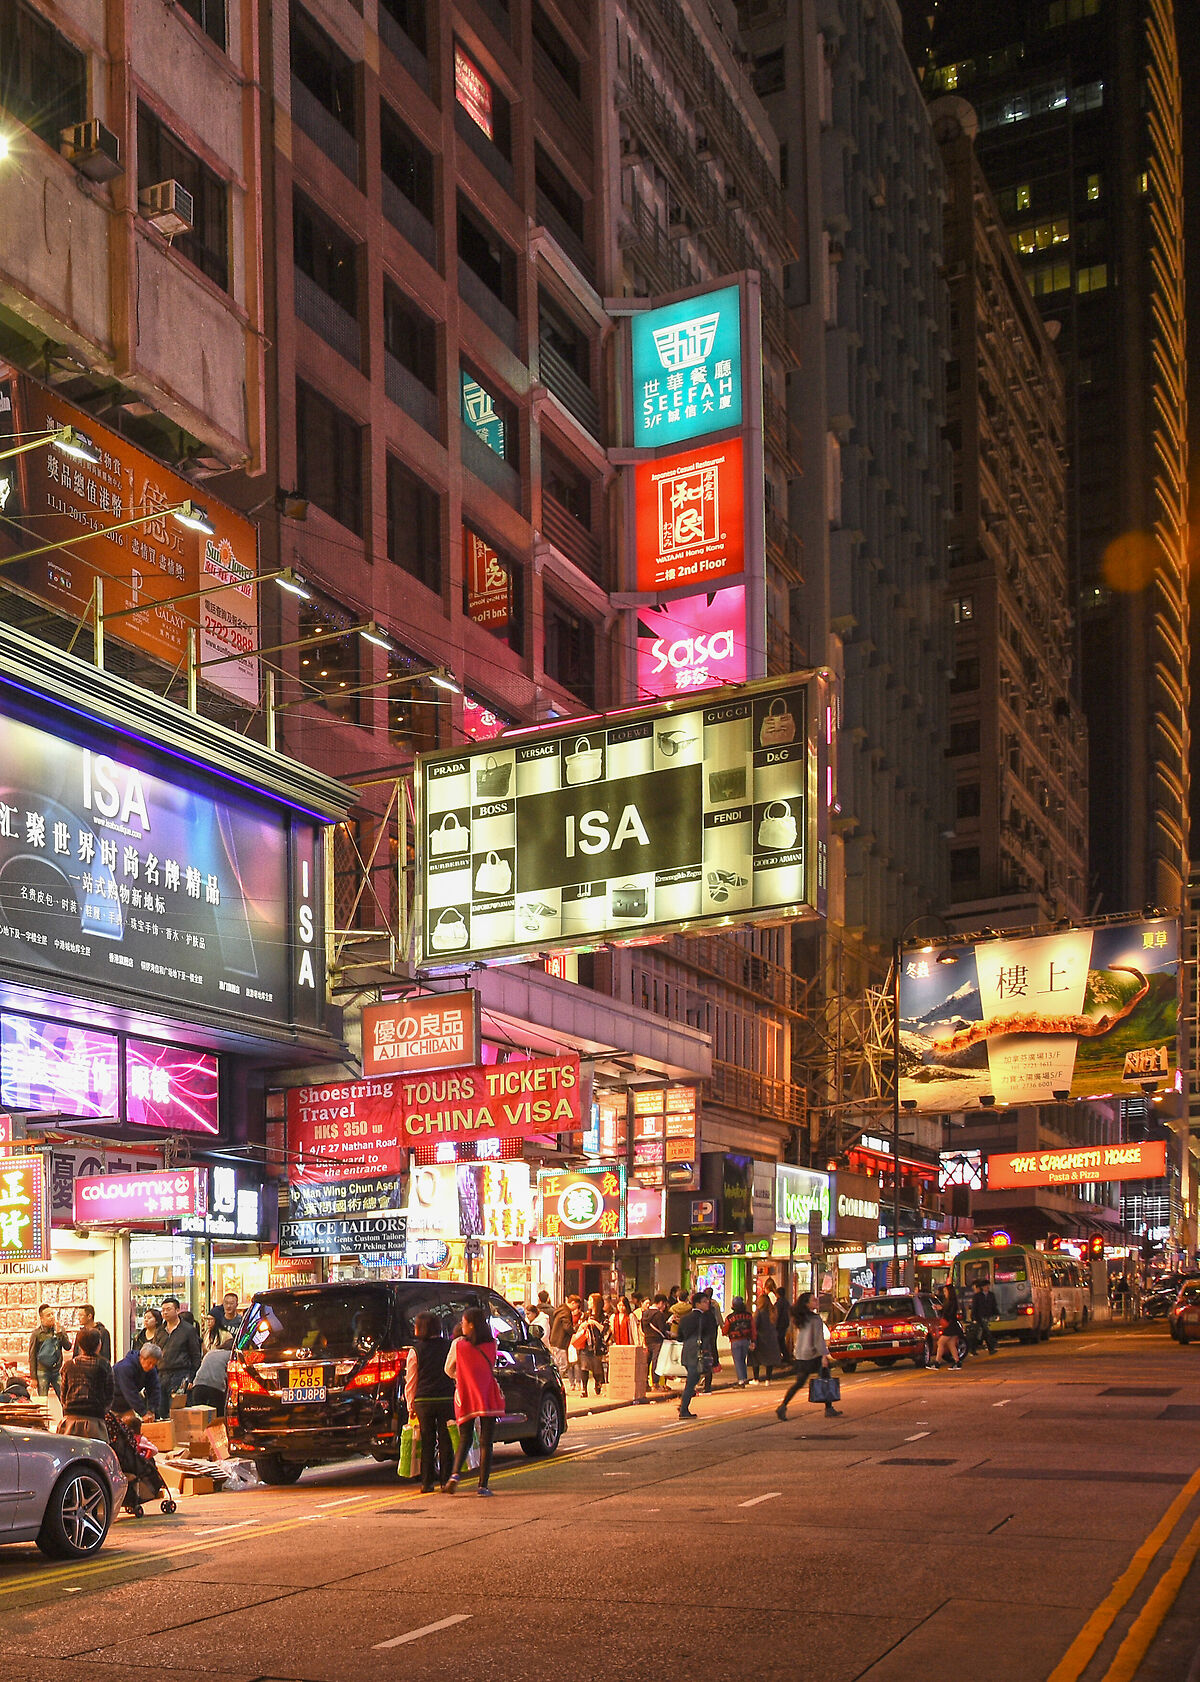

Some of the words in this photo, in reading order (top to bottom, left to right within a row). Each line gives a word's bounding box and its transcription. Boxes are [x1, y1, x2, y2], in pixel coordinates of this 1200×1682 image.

[643, 359, 732, 399] 世華餐廳
[643, 377, 733, 415] SEEFAH
[644, 413, 662, 429] 3/F
[655, 551, 684, 564] WATAMI
[686, 547, 704, 557] Hong
[706, 543, 724, 552] Kong
[655, 569, 676, 583] 二樓
[678, 560, 698, 577] 2nd
[700, 557, 727, 571] Floor
[155, 604, 185, 629] GALAXY
[651, 628, 735, 676] sasa
[707, 706, 749, 721] GUCCI
[611, 726, 649, 741] LOEWE
[521, 745, 554, 758] VERSACE
[767, 749, 789, 763] D&G
[433, 763, 465, 776] PRADA
[82, 747, 152, 832] ISA
[479, 803, 508, 817] BOSS
[714, 810, 742, 823] FENDI
[565, 804, 650, 858] ISA
[0, 802, 220, 907] 汇聚世界时尚名牌精品
[754, 857, 779, 867] GIORGIO
[780, 853, 802, 864] ARMANI
[430, 860, 470, 872] BURBERRY
[69, 872, 166, 915] 一站式购物新地标
[298, 861, 315, 988] ISA
[1142, 931, 1168, 949] 夏草
[996, 961, 1069, 999] 樓上
[374, 1010, 464, 1043] 優の良品
[379, 1045, 400, 1060] AJI
[405, 1037, 459, 1056] ICHIBAN
[299, 1082, 394, 1104] Shoestring
[403, 1077, 475, 1106] TOURS
[486, 1065, 575, 1096] TICKETS
[299, 1102, 356, 1122] Travel
[405, 1107, 495, 1135] CHINA
[503, 1098, 574, 1125] VISA
[314, 1123, 339, 1141] HK$
[343, 1120, 368, 1136] 350
[310, 1145, 326, 1155] 4/F
[328, 1143, 339, 1153] 27
[342, 1140, 374, 1152] Nathan
[376, 1137, 397, 1149] Road
[368, 1154, 378, 1163] to
[1010, 1156, 1036, 1173] THE
[1039, 1152, 1100, 1171] SPAGHETTI
[1103, 1148, 1141, 1166] HOUSE
[325, 1166, 340, 1176] the
[344, 1163, 388, 1175] entrance
[1049, 1172, 1069, 1182] Pasta
[1071, 1171, 1078, 1180] &
[1080, 1169, 1099, 1180] Pizza
[302, 1187, 321, 1198] Man
[323, 1185, 347, 1198] Wing
[349, 1182, 374, 1194] Chun
[376, 1180, 399, 1191] Assn
[281, 1221, 336, 1237] PRINCE
[340, 1218, 406, 1234] TAILORS
[303, 1236, 325, 1246] Ladies
[326, 1236, 332, 1244] &
[333, 1235, 353, 1244] Gents
[354, 1233, 381, 1242] Custom
[382, 1231, 405, 1241] Tailors
[340, 1244, 352, 1252] No.
[354, 1243, 362, 1251] 77
[363, 1242, 386, 1252] Peking
[387, 1241, 405, 1249] Road
[825, 1245, 862, 1254] IORDANO
[277, 1258, 313, 1267] MAGAZINES
[292, 1377, 320, 1388] 7685
